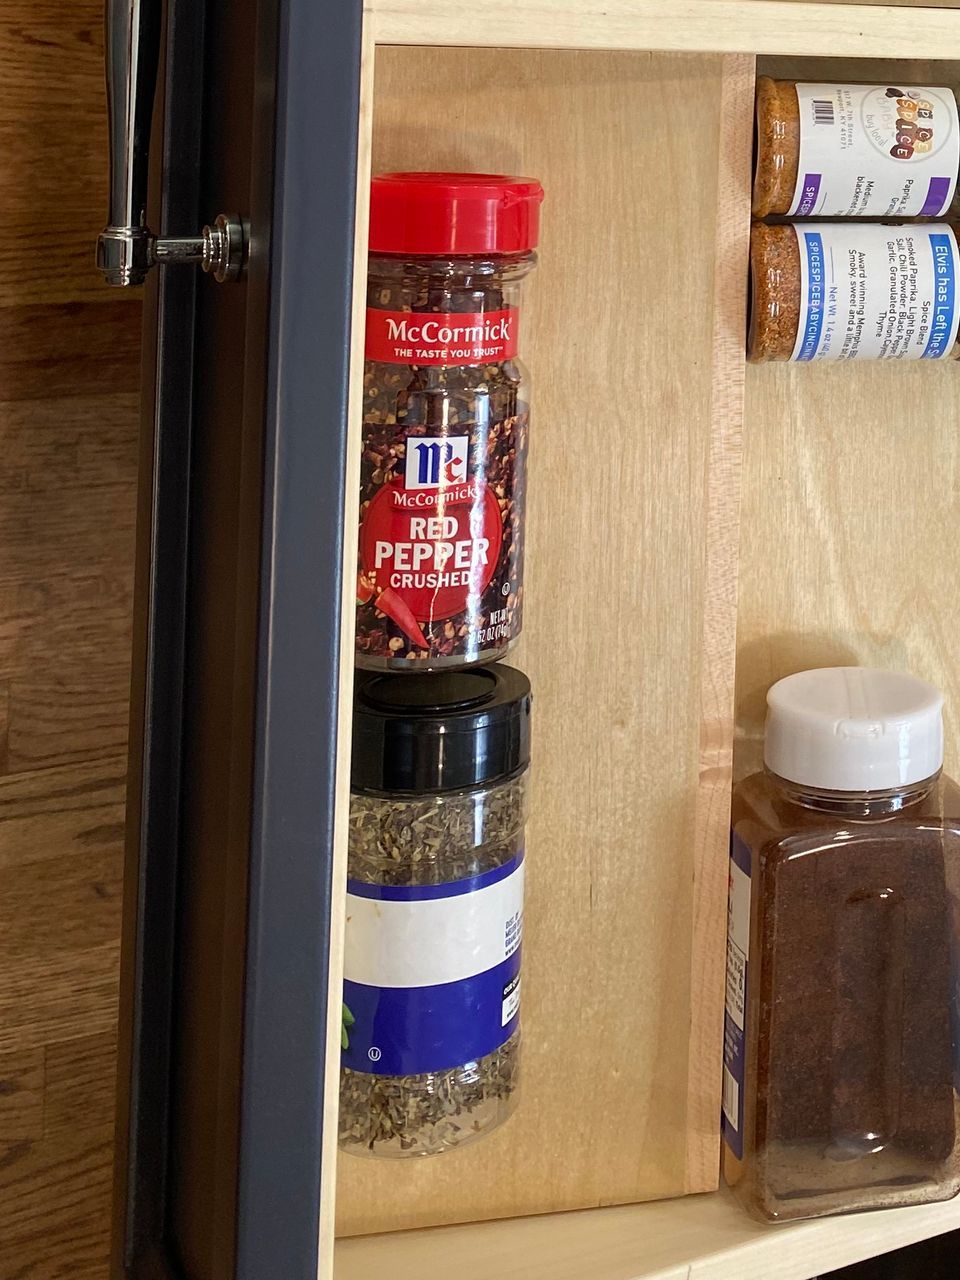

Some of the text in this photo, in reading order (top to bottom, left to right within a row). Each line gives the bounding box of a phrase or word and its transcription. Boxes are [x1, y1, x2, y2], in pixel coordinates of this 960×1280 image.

[849, 176, 865, 208] blackened
[861, 181, 874, 207] Medium
[830, 287, 838, 302] Net
[852, 252, 866, 349] Award winning Memphis
[889, 267, 897, 313] Granulated
[896, 254, 907, 333] Chili Black
[902, 237, 917, 349] Smoked Light Brown
[931, 246, 949, 348] Elvis has Left the
[848, 310, 856, 325] and
[876, 311, 887, 337] Thyme
[920, 301, 930, 323] Spice
[385, 317, 510, 343] McCormick
[394, 348, 471, 358] THE TASTE YOU
[410, 517, 459, 540] RED
[375, 539, 489, 570] PEPPER
[390, 572, 470, 588] CRUSHED
